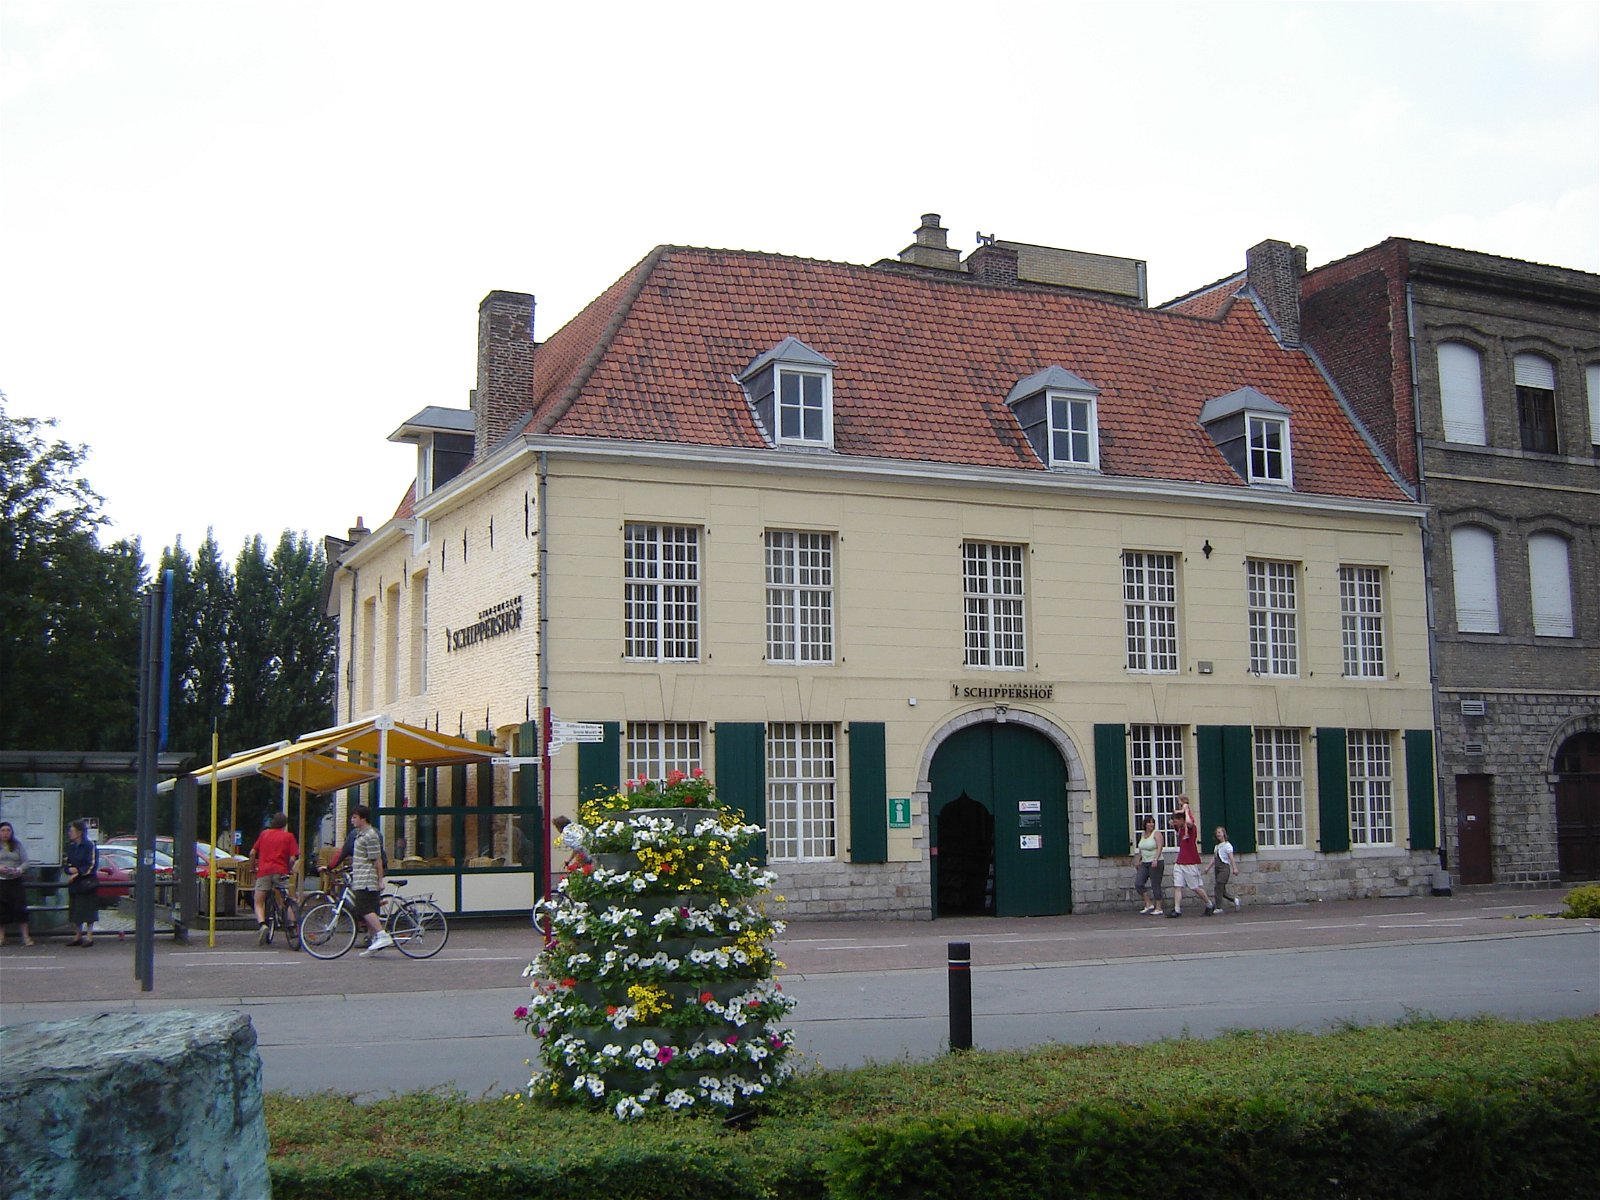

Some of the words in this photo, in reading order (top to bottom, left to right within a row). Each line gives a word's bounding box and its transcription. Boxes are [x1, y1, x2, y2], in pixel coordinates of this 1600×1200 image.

[452, 606, 522, 651] SCHIPPERSHOF
[952, 683, 960, 697] 't
[963, 687, 1053, 699] SCHIPPERSHOF
[234, 832, 242, 844] P
